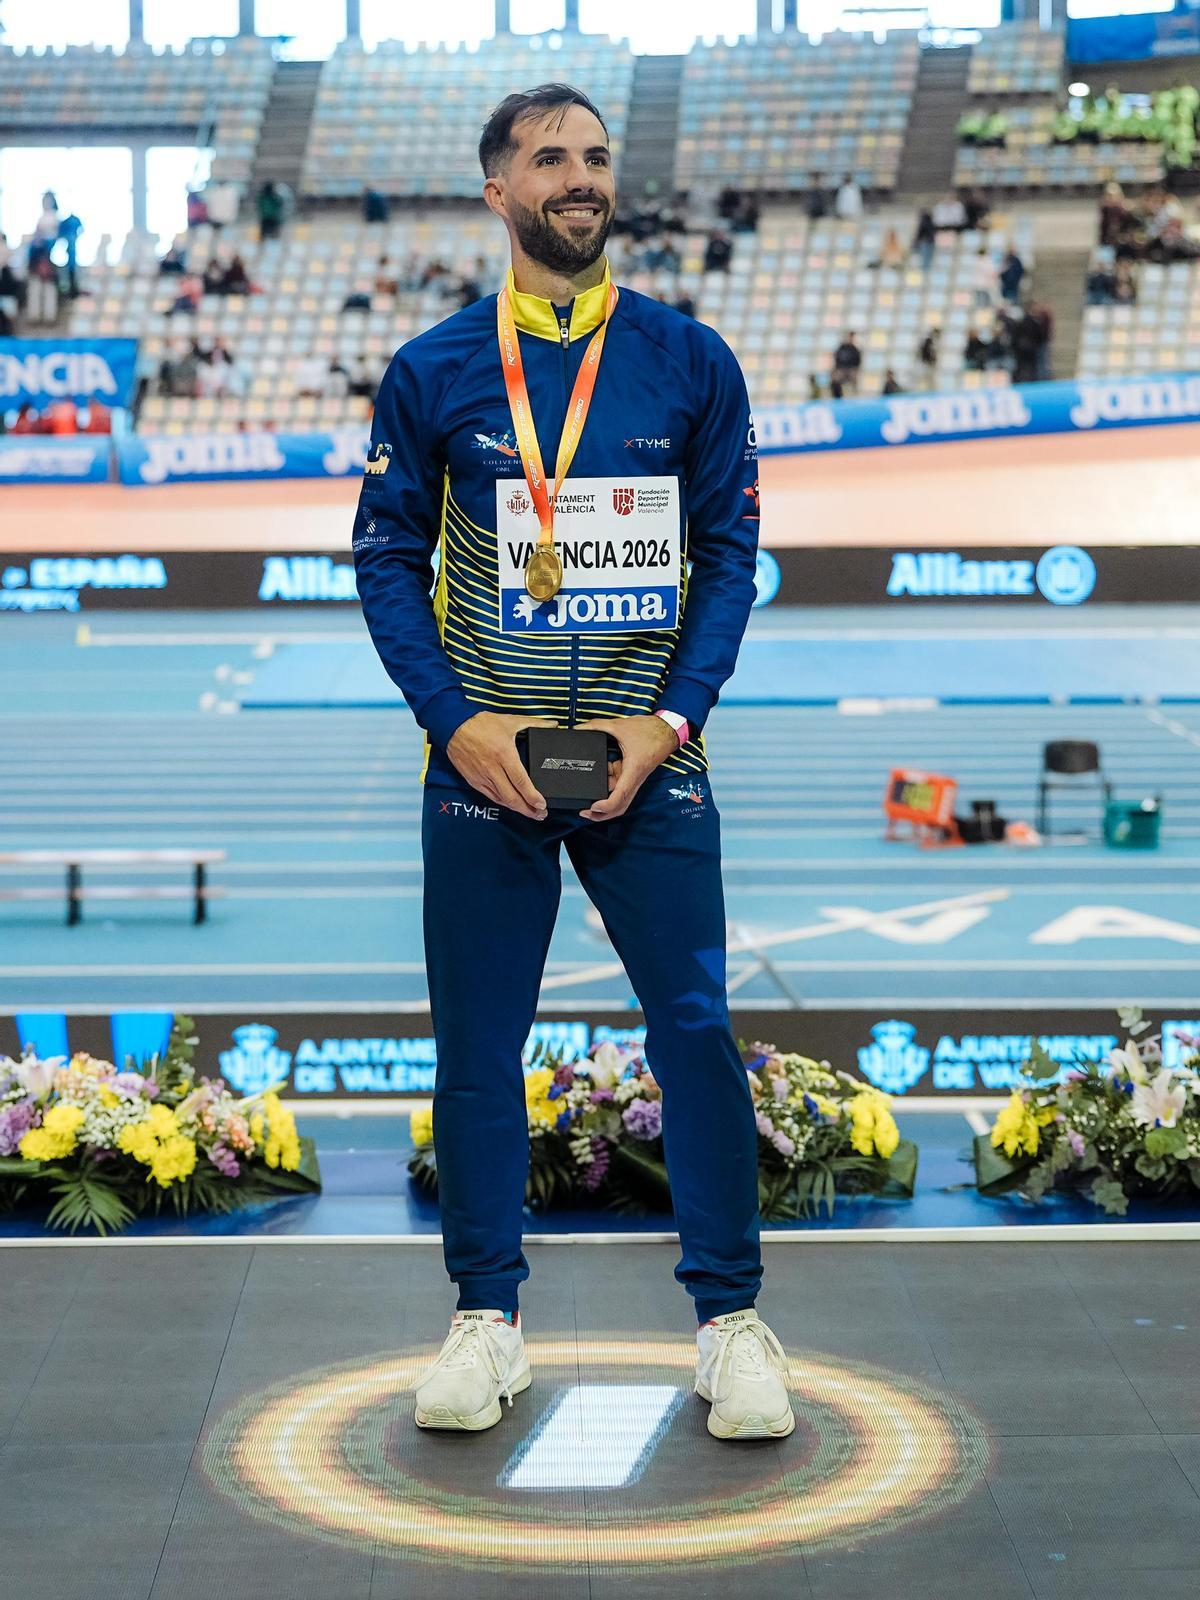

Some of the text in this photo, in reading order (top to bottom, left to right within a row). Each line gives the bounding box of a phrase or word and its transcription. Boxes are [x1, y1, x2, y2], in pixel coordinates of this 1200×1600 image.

[0, 353, 117, 397] NCIA
[754, 407, 843, 449] ma
[623, 438, 671, 449] XTYME
[554, 504, 595, 514] ALÈNCIA
[508, 539, 671, 569] VANCIA 2026
[258, 557, 360, 600] Allia
[887, 553, 1036, 596] Allianz
[438, 800, 500, 820] XTYME
[294, 1064, 337, 1092] DE
